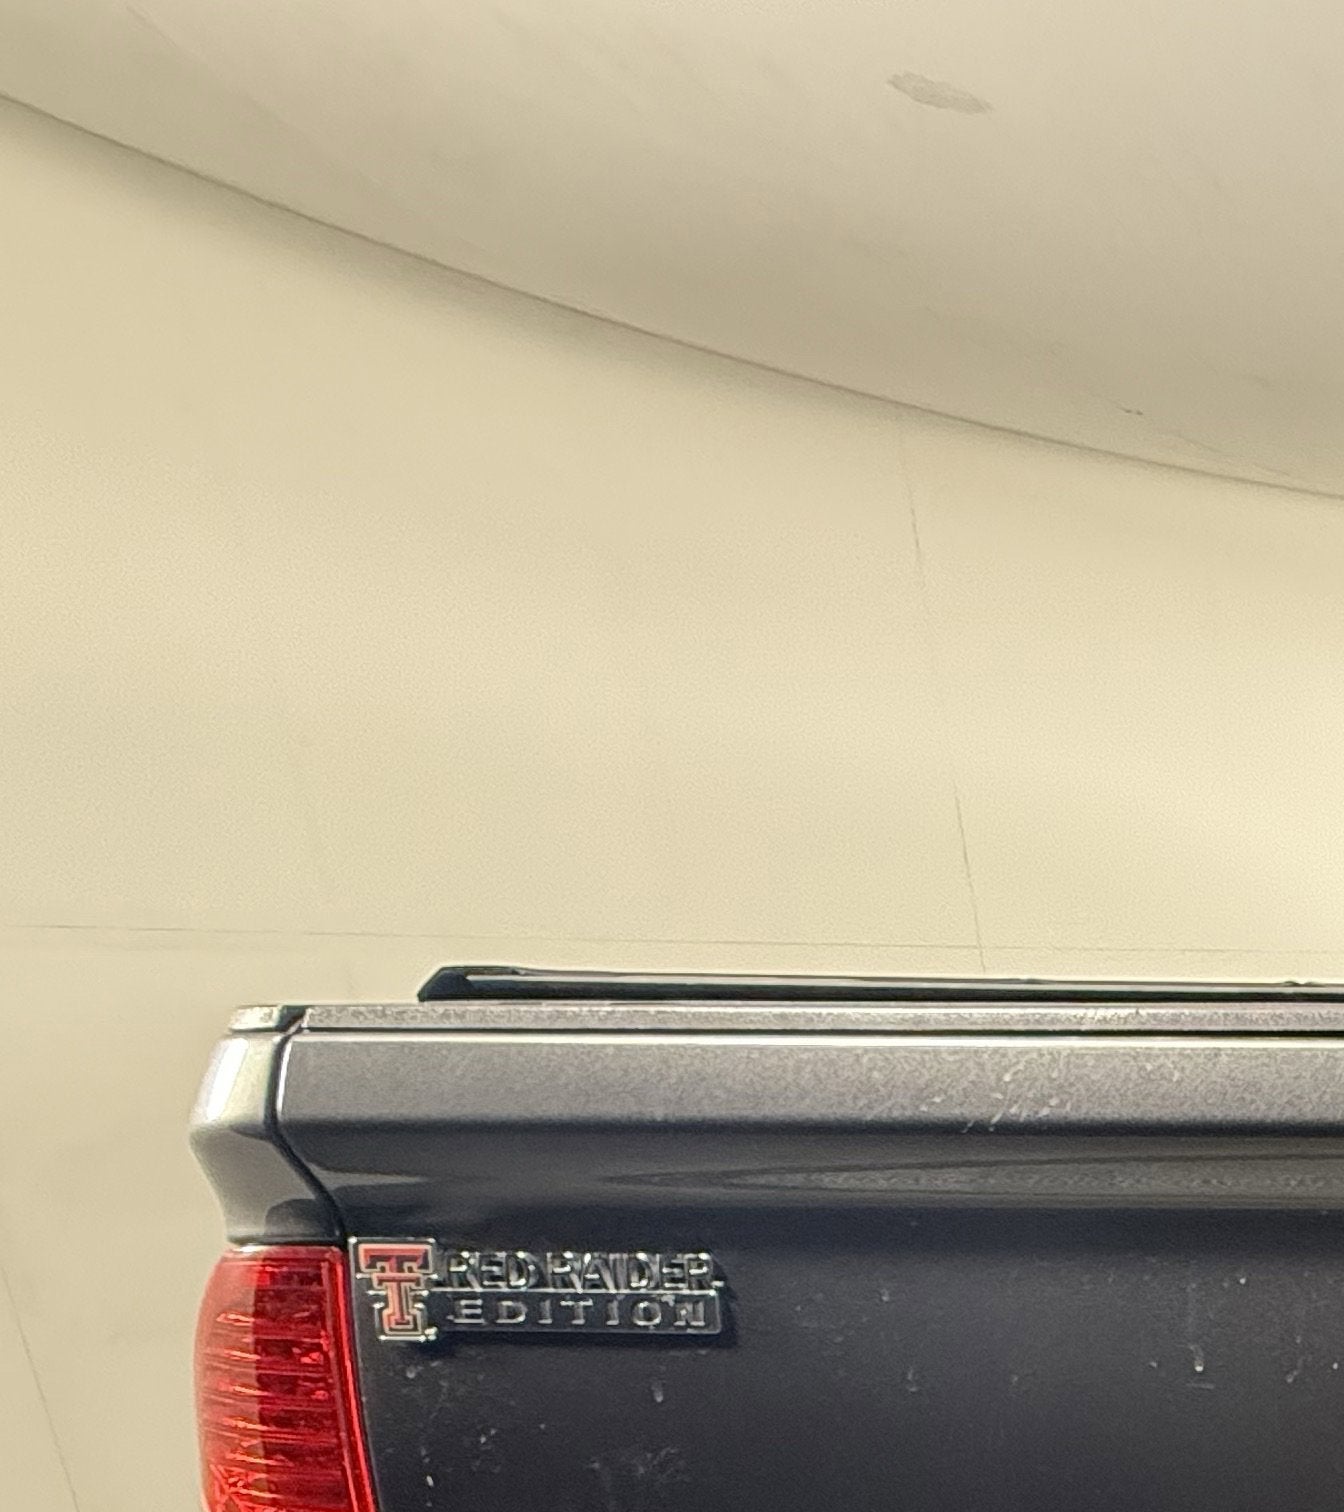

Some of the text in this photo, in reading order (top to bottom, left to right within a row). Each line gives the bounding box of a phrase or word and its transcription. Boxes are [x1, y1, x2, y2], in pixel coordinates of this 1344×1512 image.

[448, 1252, 724, 1291] RED RAIDER
[450, 1298, 706, 1327] EDITION
